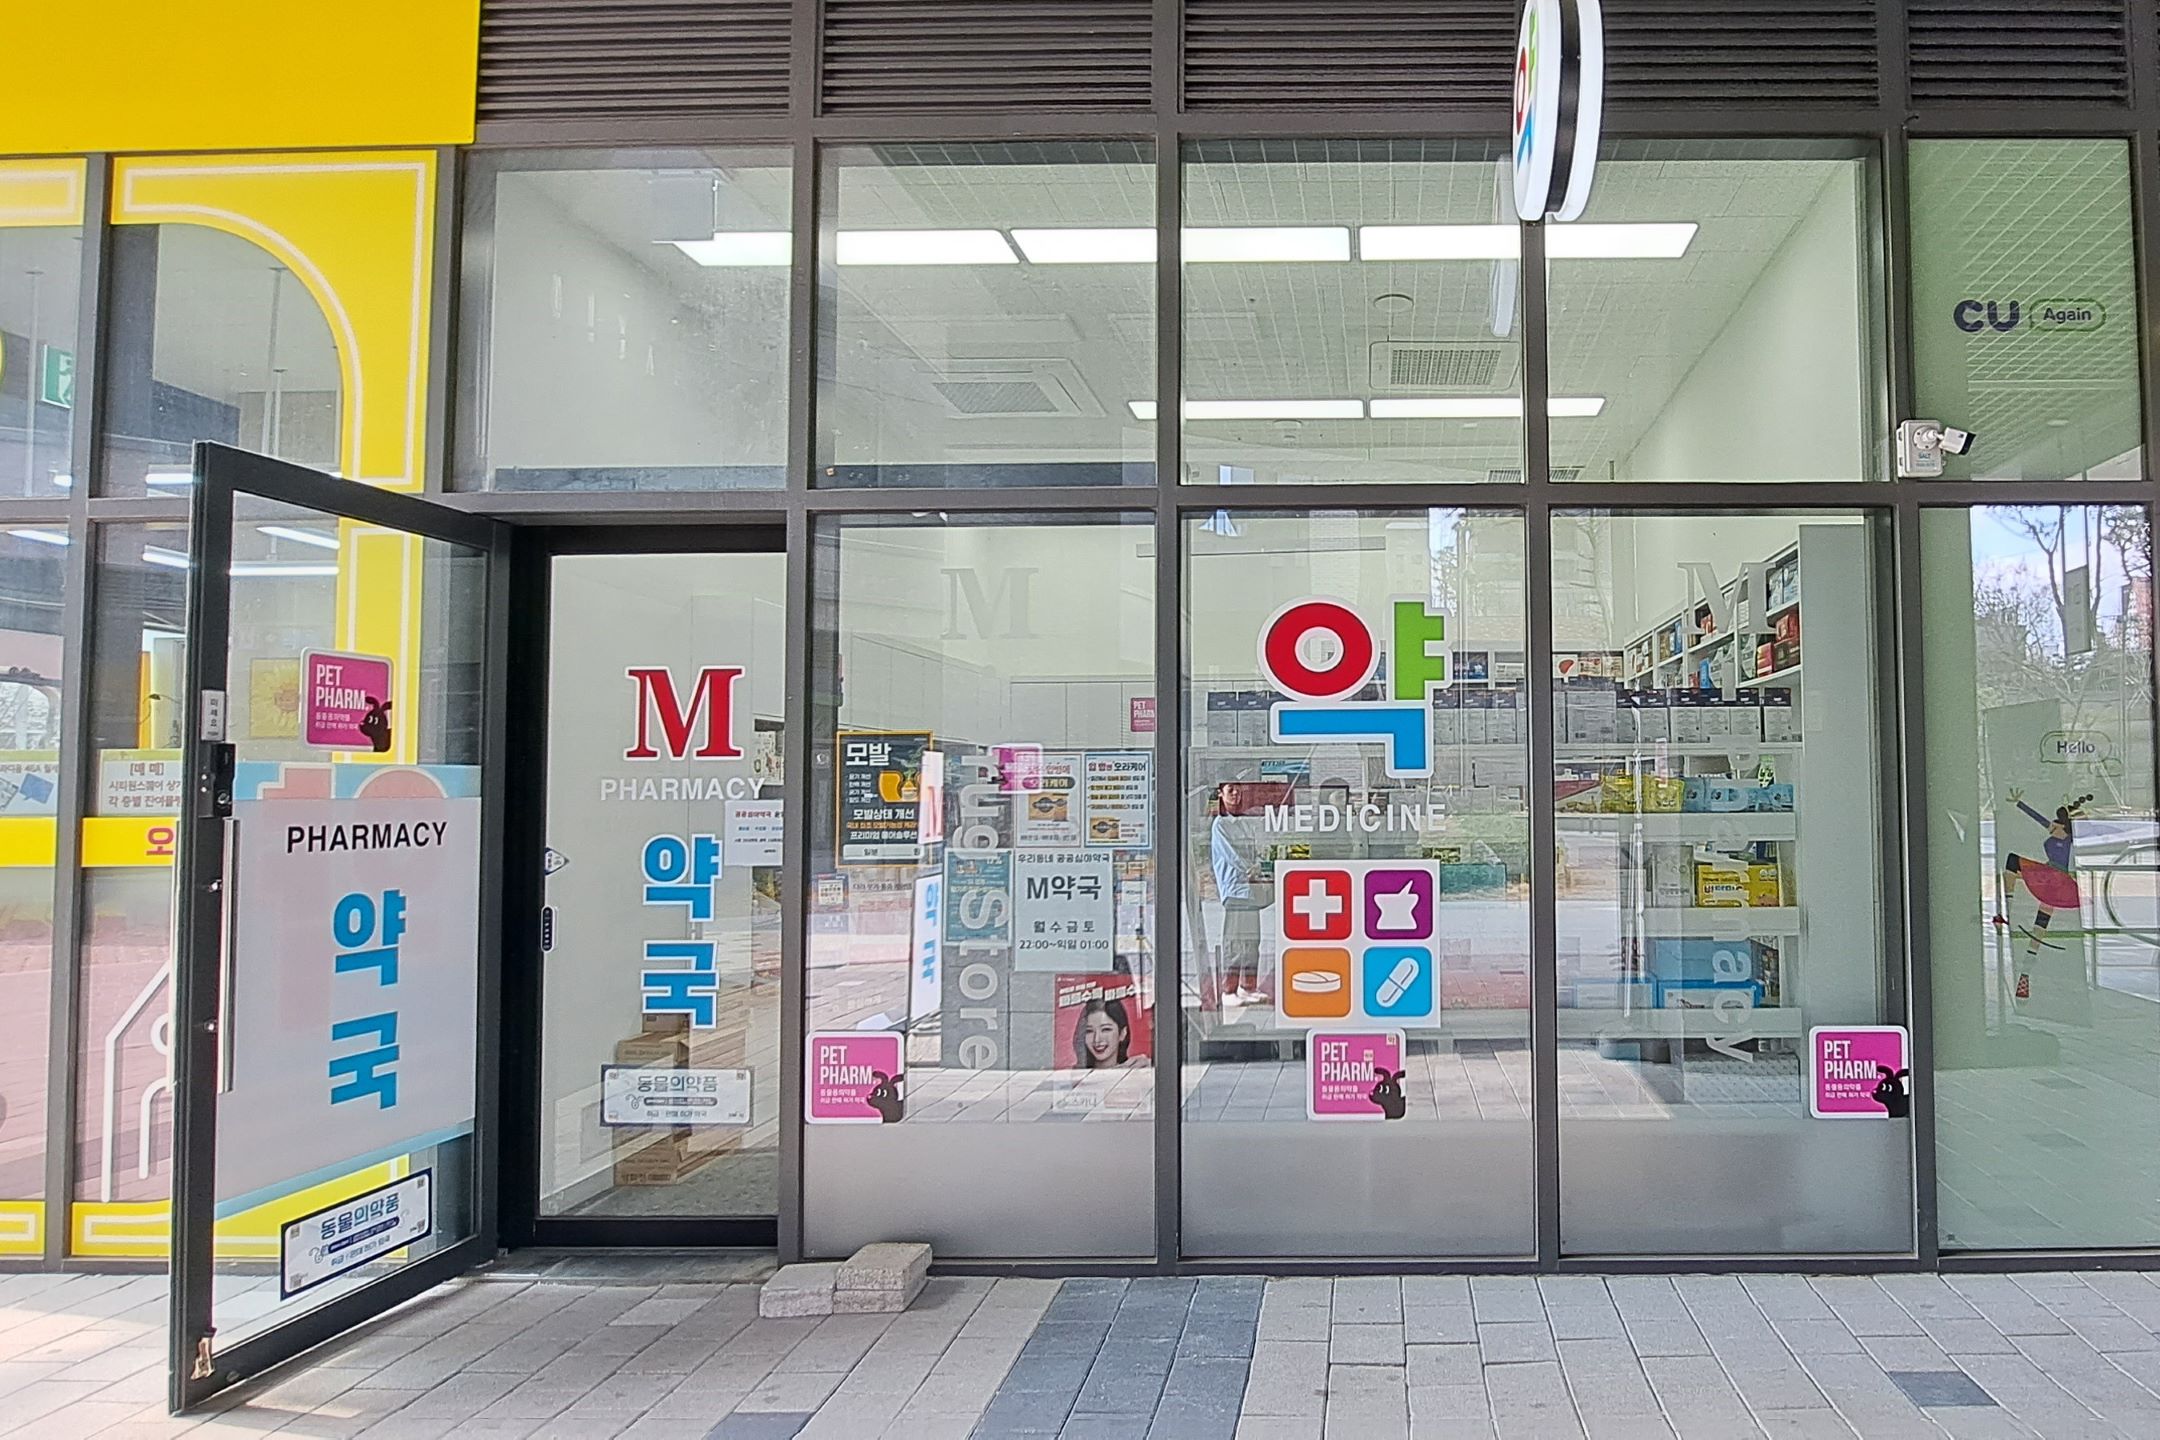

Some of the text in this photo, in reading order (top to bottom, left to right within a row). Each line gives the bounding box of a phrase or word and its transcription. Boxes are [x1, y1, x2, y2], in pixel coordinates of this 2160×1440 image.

[1953, 300, 2020, 332] CU
[2043, 307, 2092, 324] Again
[940, 567, 1040, 640] M
[1677, 561, 1777, 634] M
[316, 664, 343, 686] PET
[1258, 597, 1452, 776] 약
[624, 665, 745, 760] M
[846, 743, 892, 766] 모발
[2056, 740, 2096, 753] Hello
[600, 776, 766, 800] PHARMACY
[853, 808, 914, 820] 모발상태 개선
[1264, 803, 1447, 833] MEDICINE
[287, 822, 447, 853] PHARMACY
[1057, 853, 1110, 863] 공공심야약국
[1027, 875, 1102, 901] M약국
[641, 834, 723, 1029] 약국
[1050, 921, 1062, 933] 수
[1066, 921, 1078, 933] 금
[1083, 921, 1095, 932] 토
[1080, 940, 1109, 949] 01:00
[328, 889, 407, 1109] 약국
[820, 1046, 848, 1065] PET
[1321, 1042, 1348, 1061] PET
[1824, 1040, 1851, 1059] PET
[638, 1075, 719, 1093] 동물의약품
[321, 1192, 399, 1240] 동물의약품
